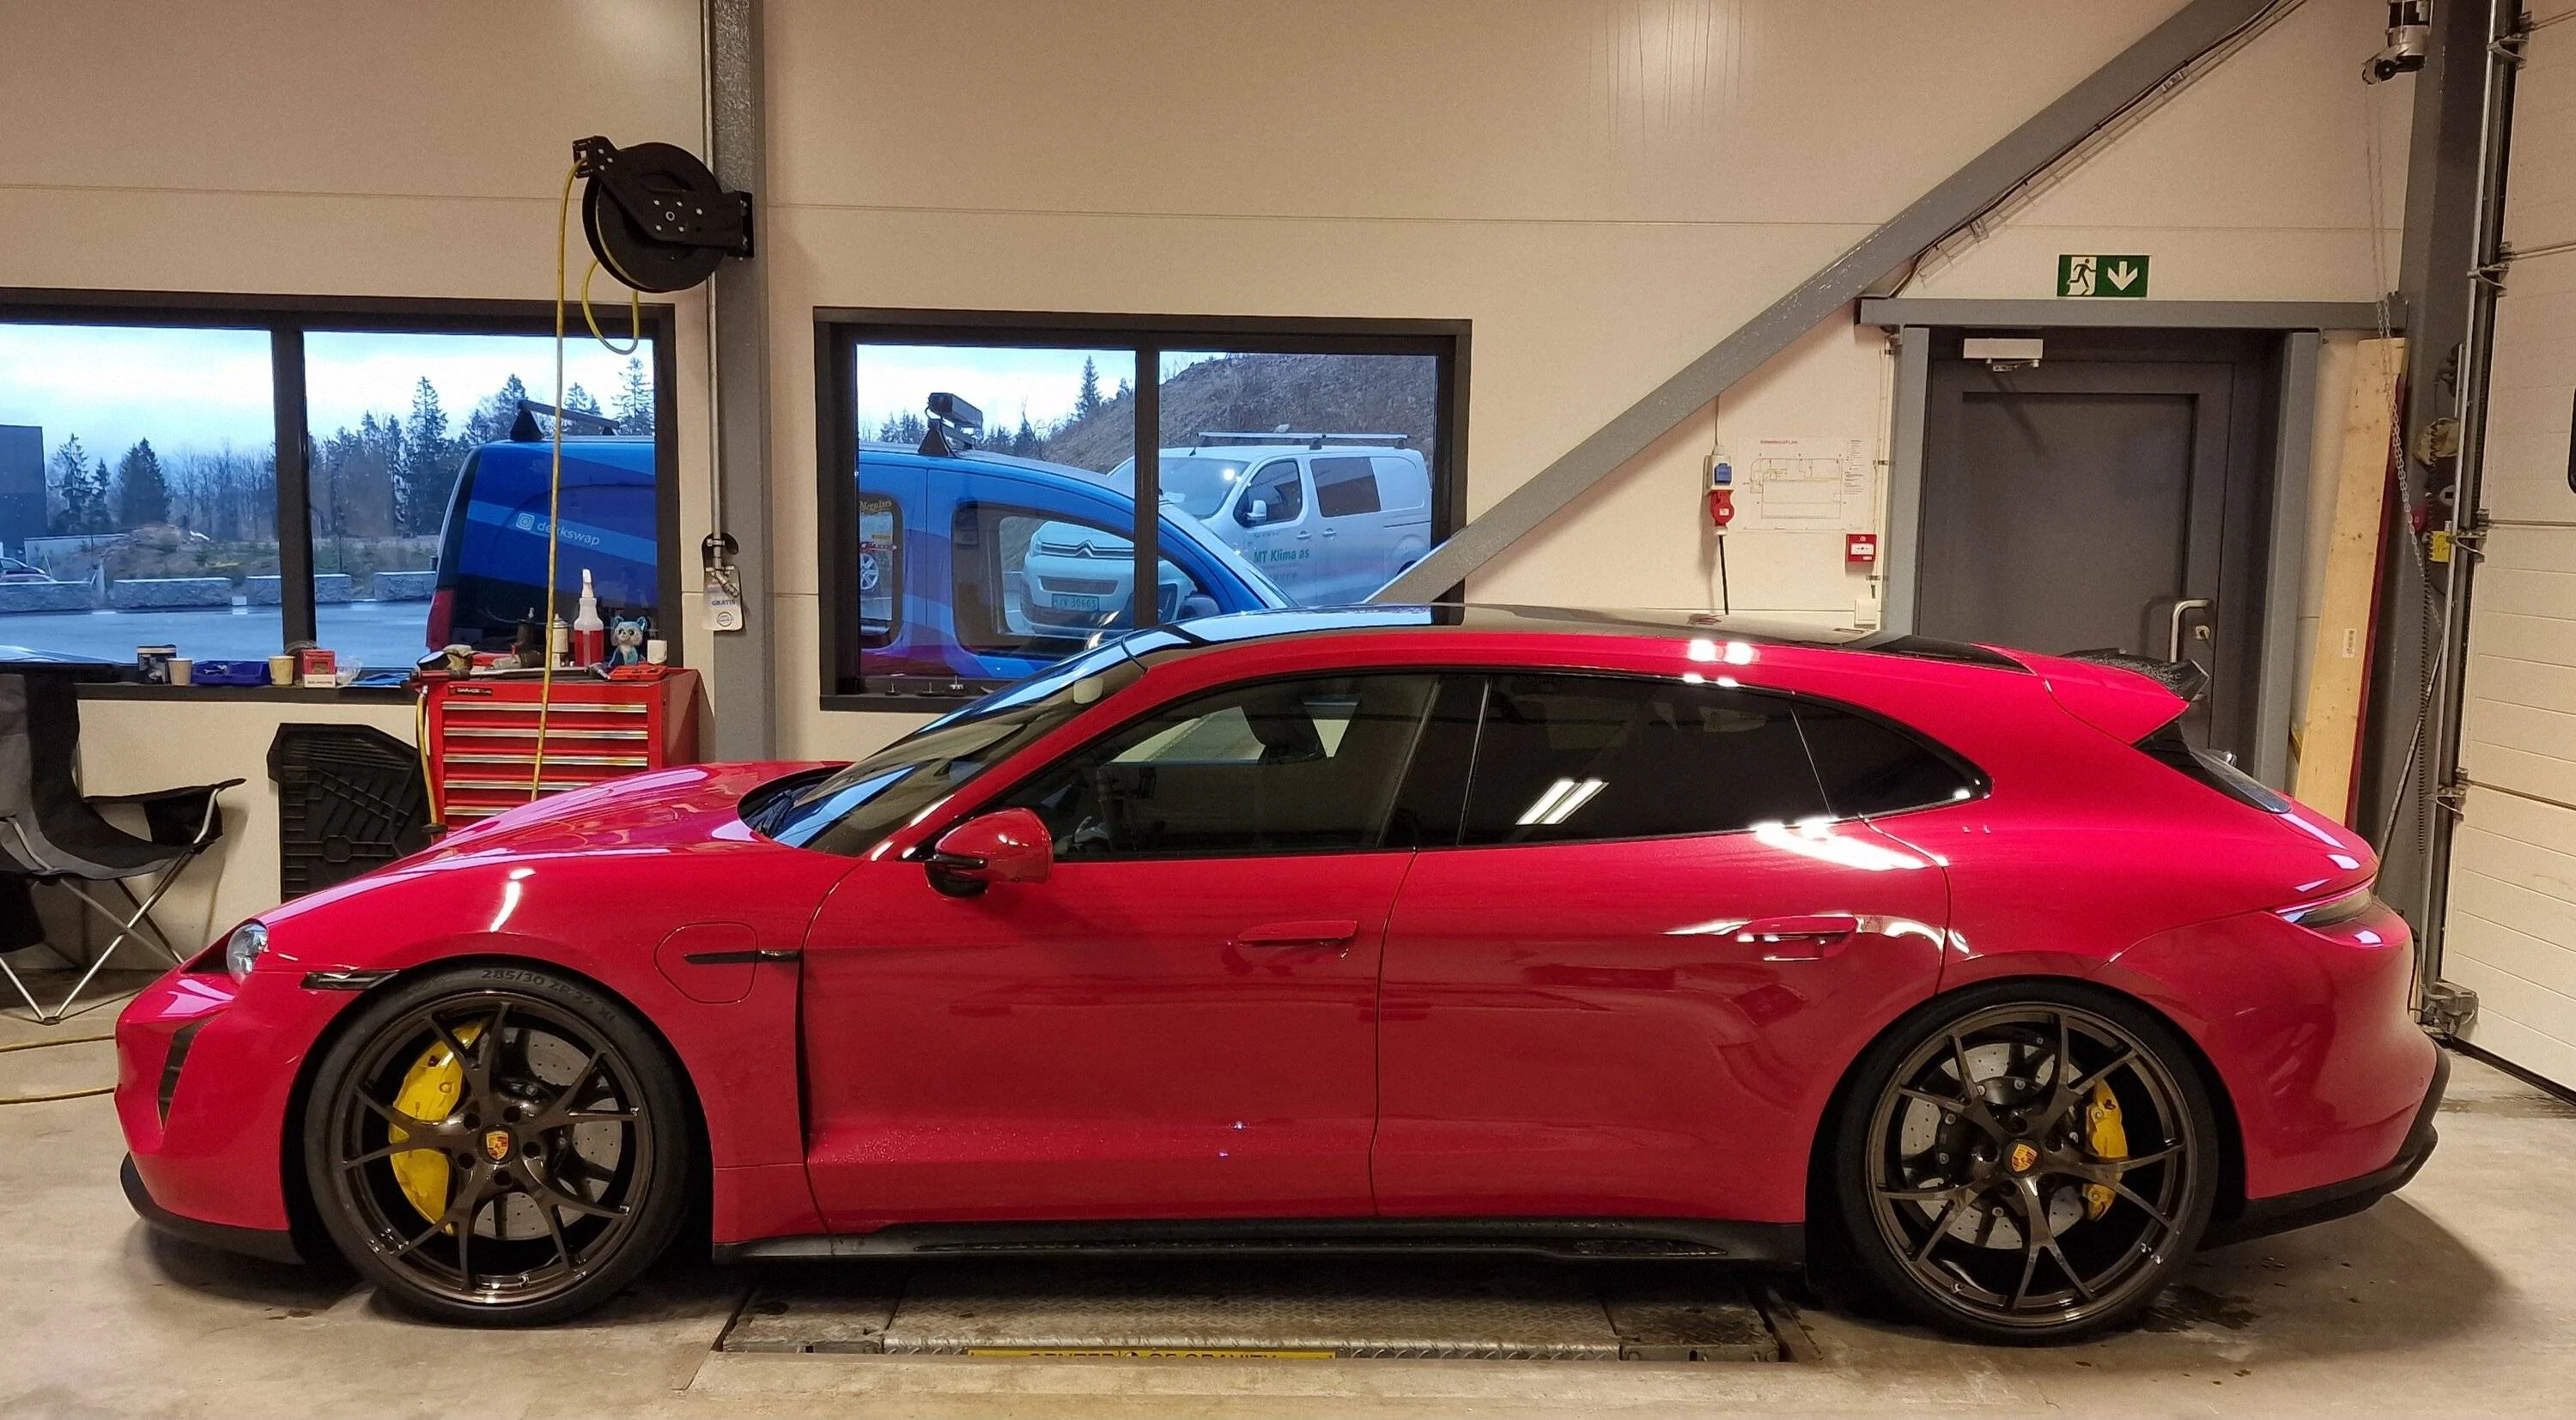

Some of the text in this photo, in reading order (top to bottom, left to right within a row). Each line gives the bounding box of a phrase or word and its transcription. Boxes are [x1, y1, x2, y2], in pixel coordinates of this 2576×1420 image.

[537, 521, 599, 546] dekswap
[1271, 549, 1296, 561] Klima
[1299, 549, 1310, 559] as
[482, 969, 544, 986] 285/30
